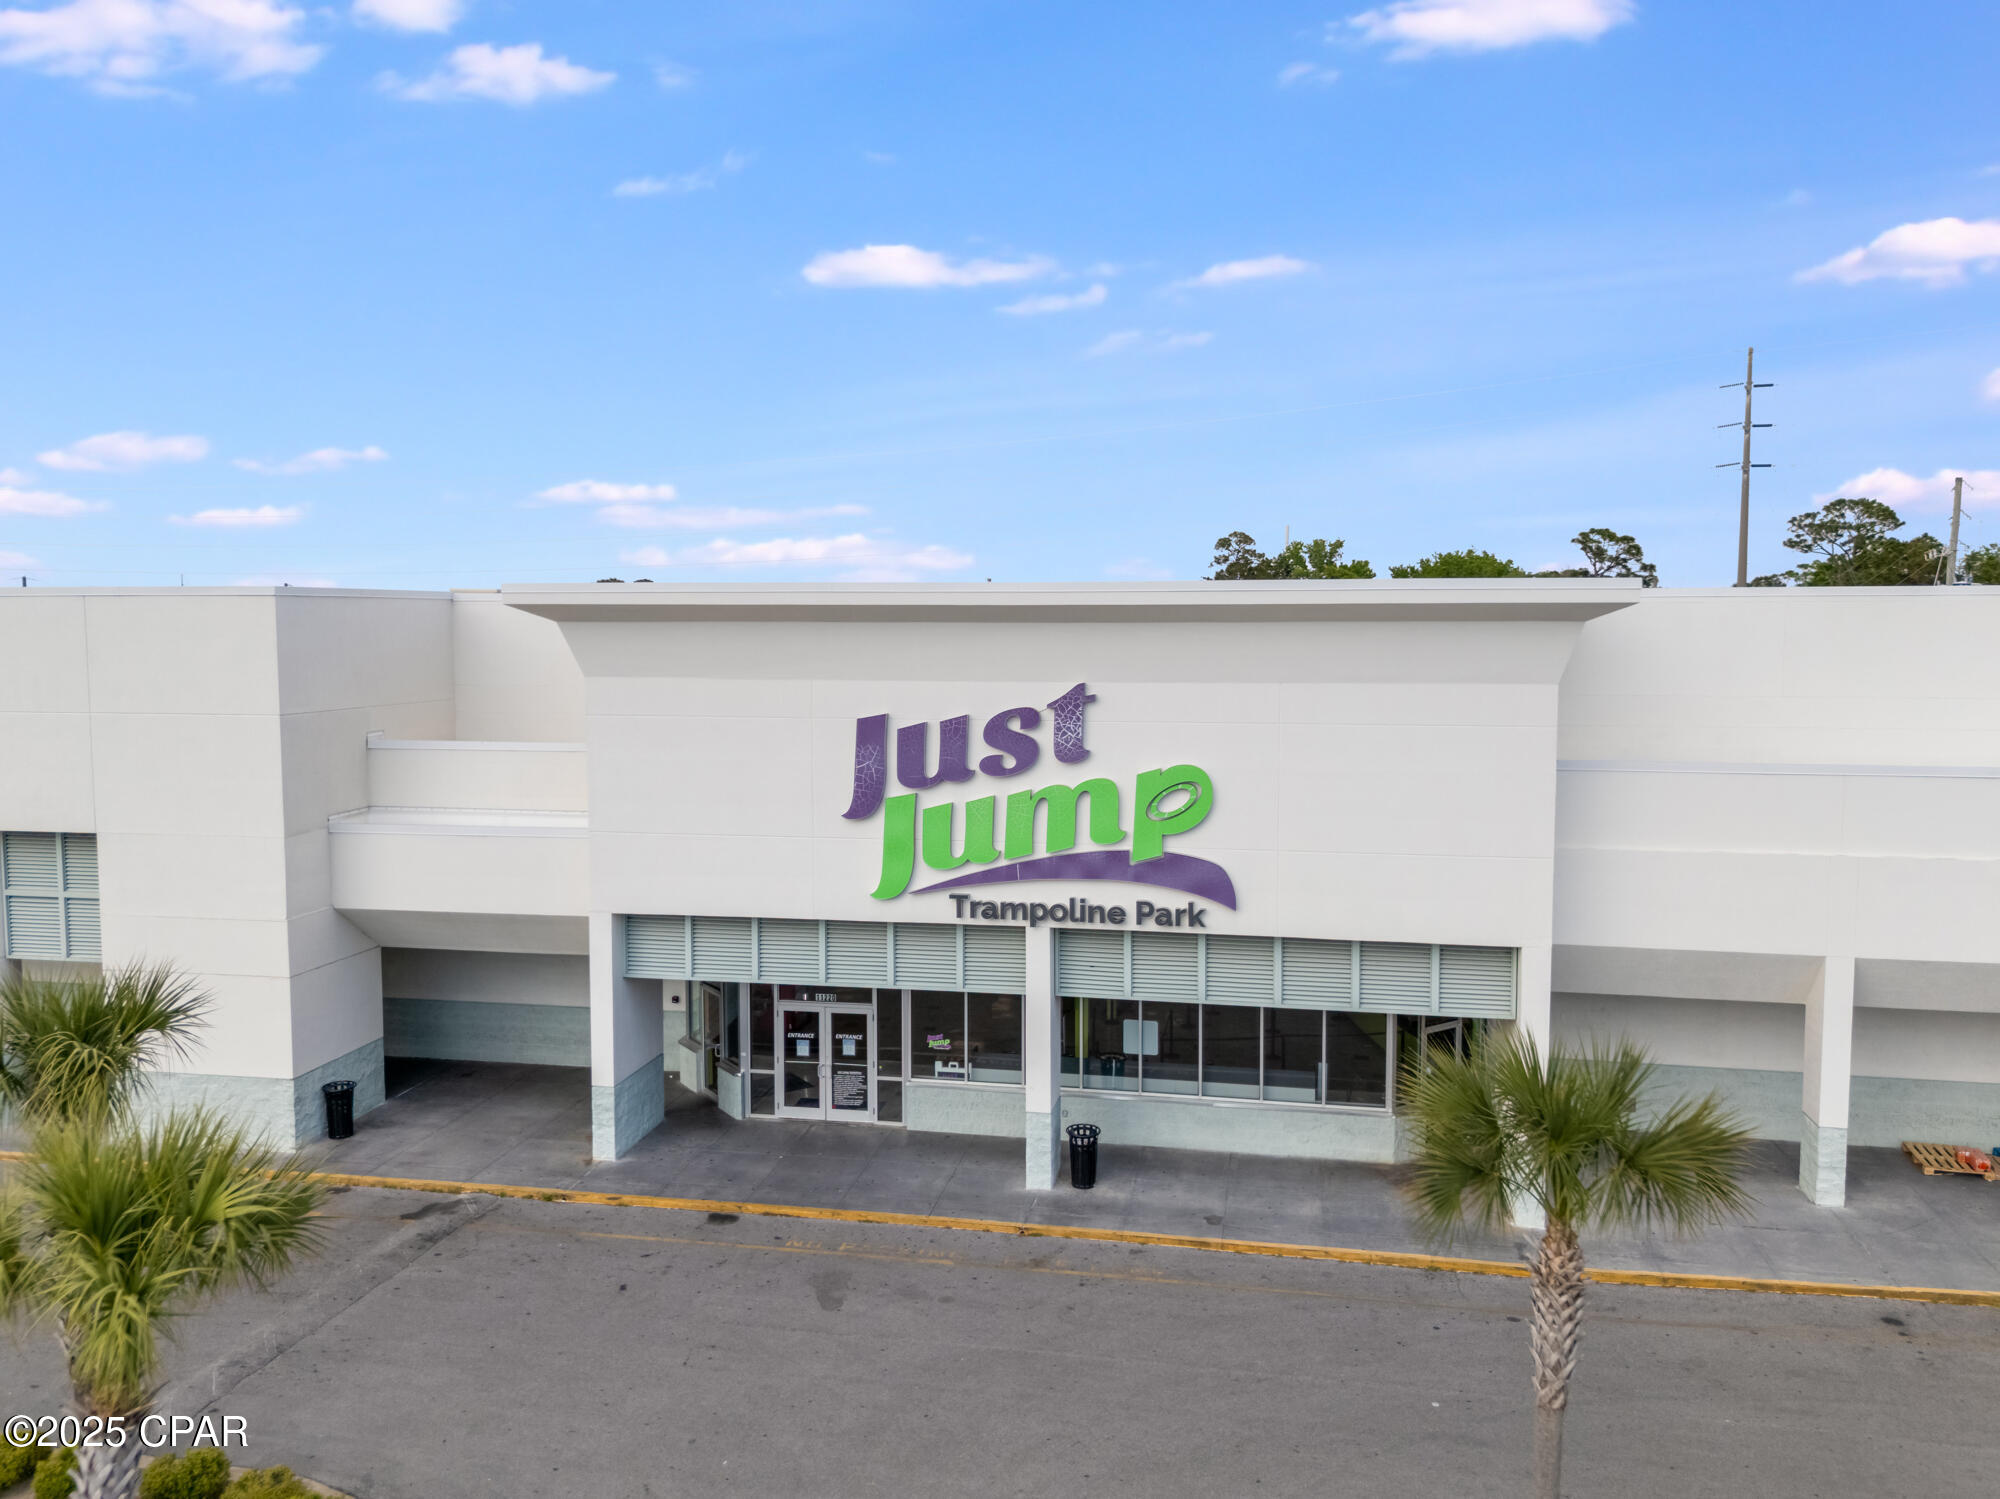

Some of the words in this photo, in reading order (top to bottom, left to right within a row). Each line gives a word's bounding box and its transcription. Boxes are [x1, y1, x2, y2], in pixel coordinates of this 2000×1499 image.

[841, 682, 1097, 820] Just
[870, 764, 1214, 900] Jump
[949, 892, 1127, 928] Trampoline
[1135, 900, 1207, 928] Park
